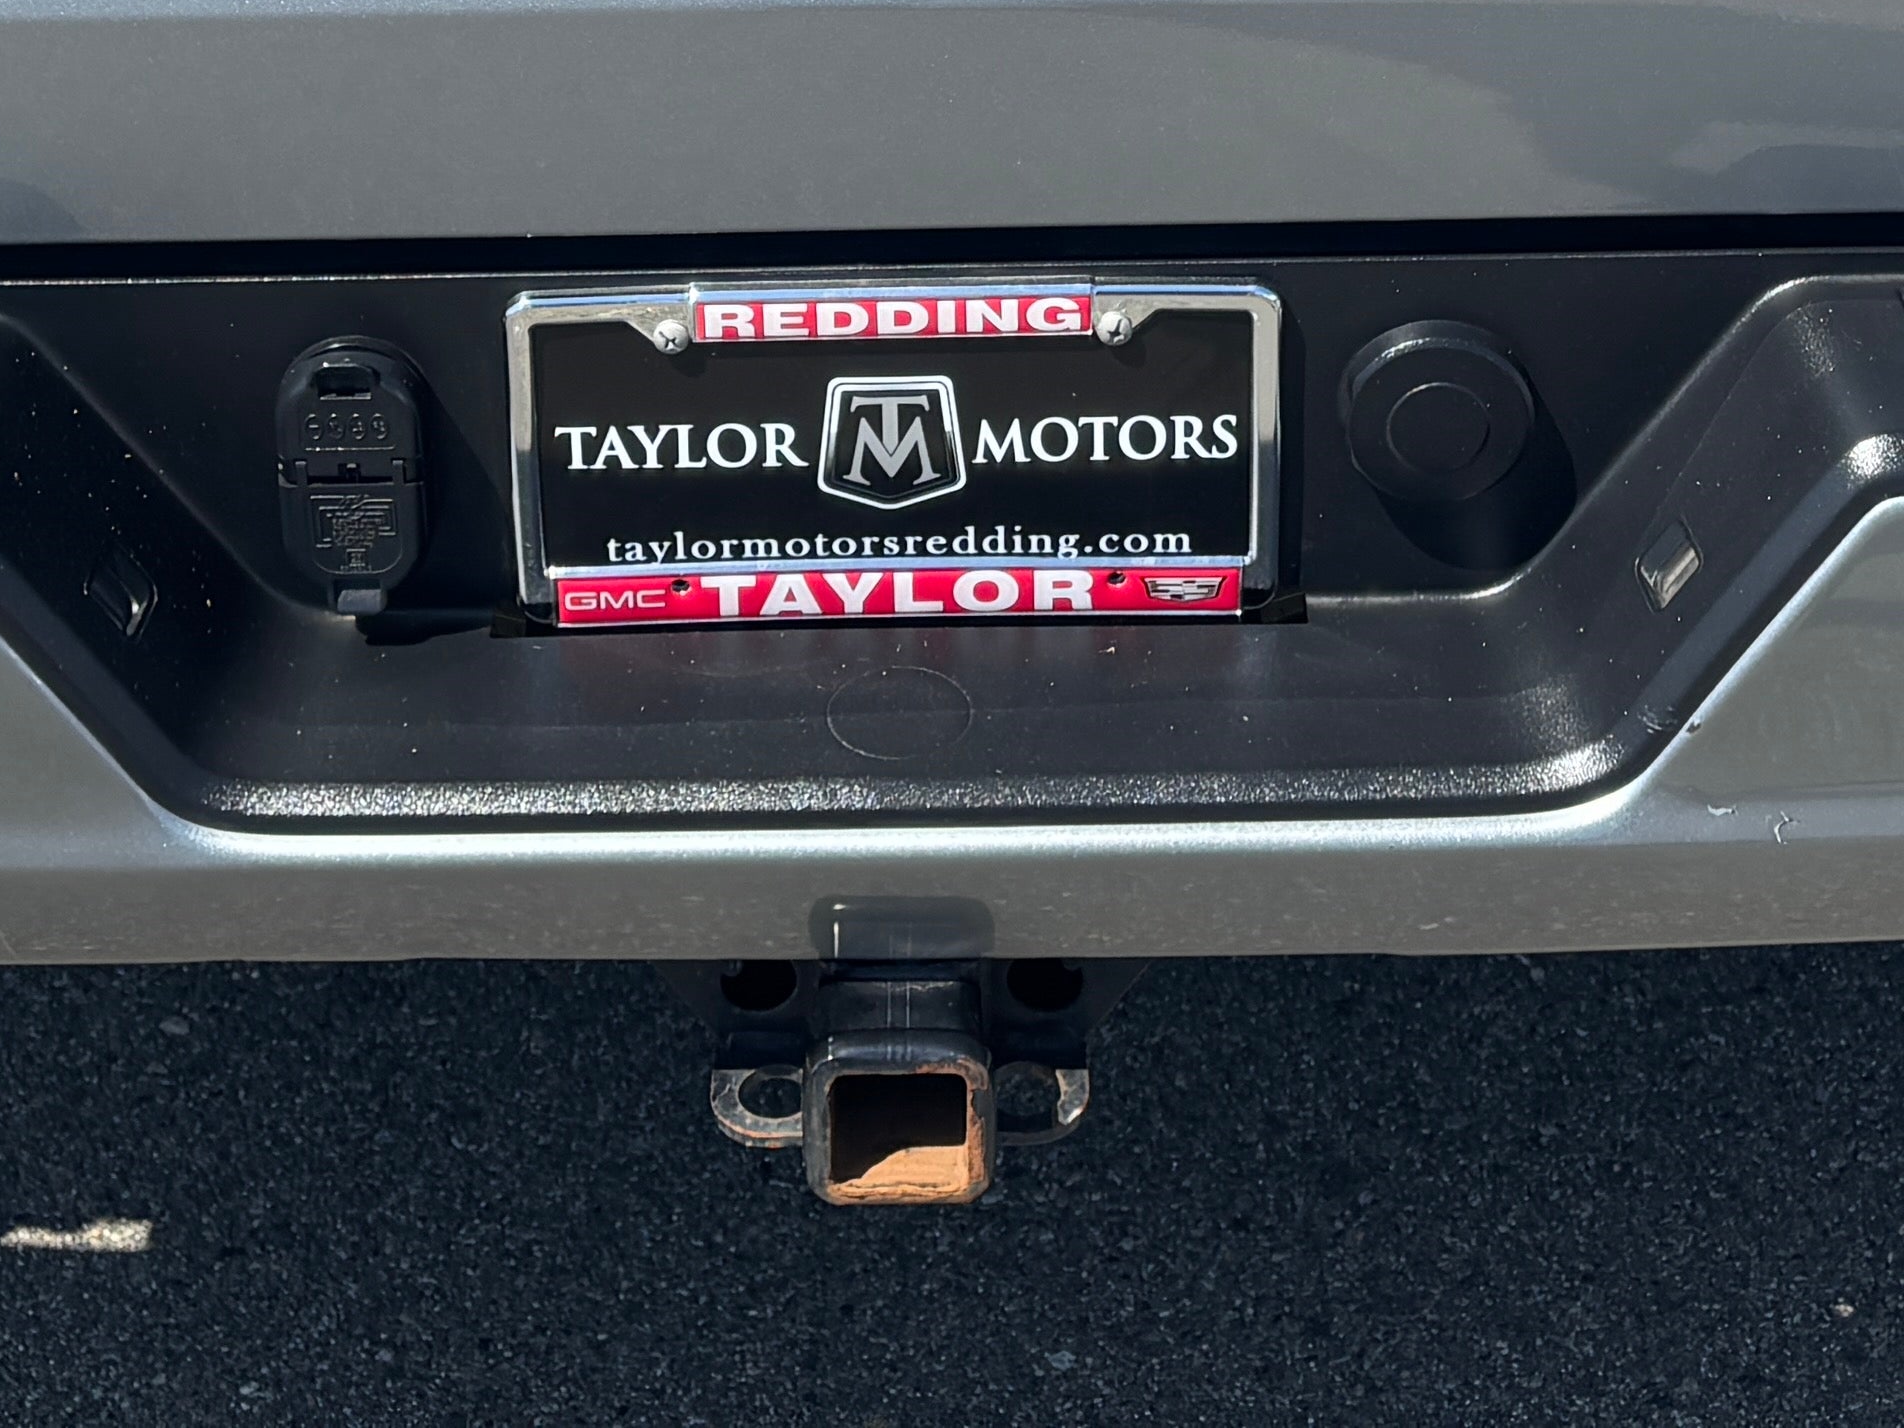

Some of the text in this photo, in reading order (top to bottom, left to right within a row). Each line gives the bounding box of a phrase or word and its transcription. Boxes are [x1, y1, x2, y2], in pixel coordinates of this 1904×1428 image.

[703, 297, 1084, 339] REDDING
[554, 422, 809, 471] TAYLOR
[971, 413, 1239, 465] MOTORS
[607, 525, 1192, 564] taylormotorsredding.com
[564, 569, 1095, 617] GMC TAYLOR
